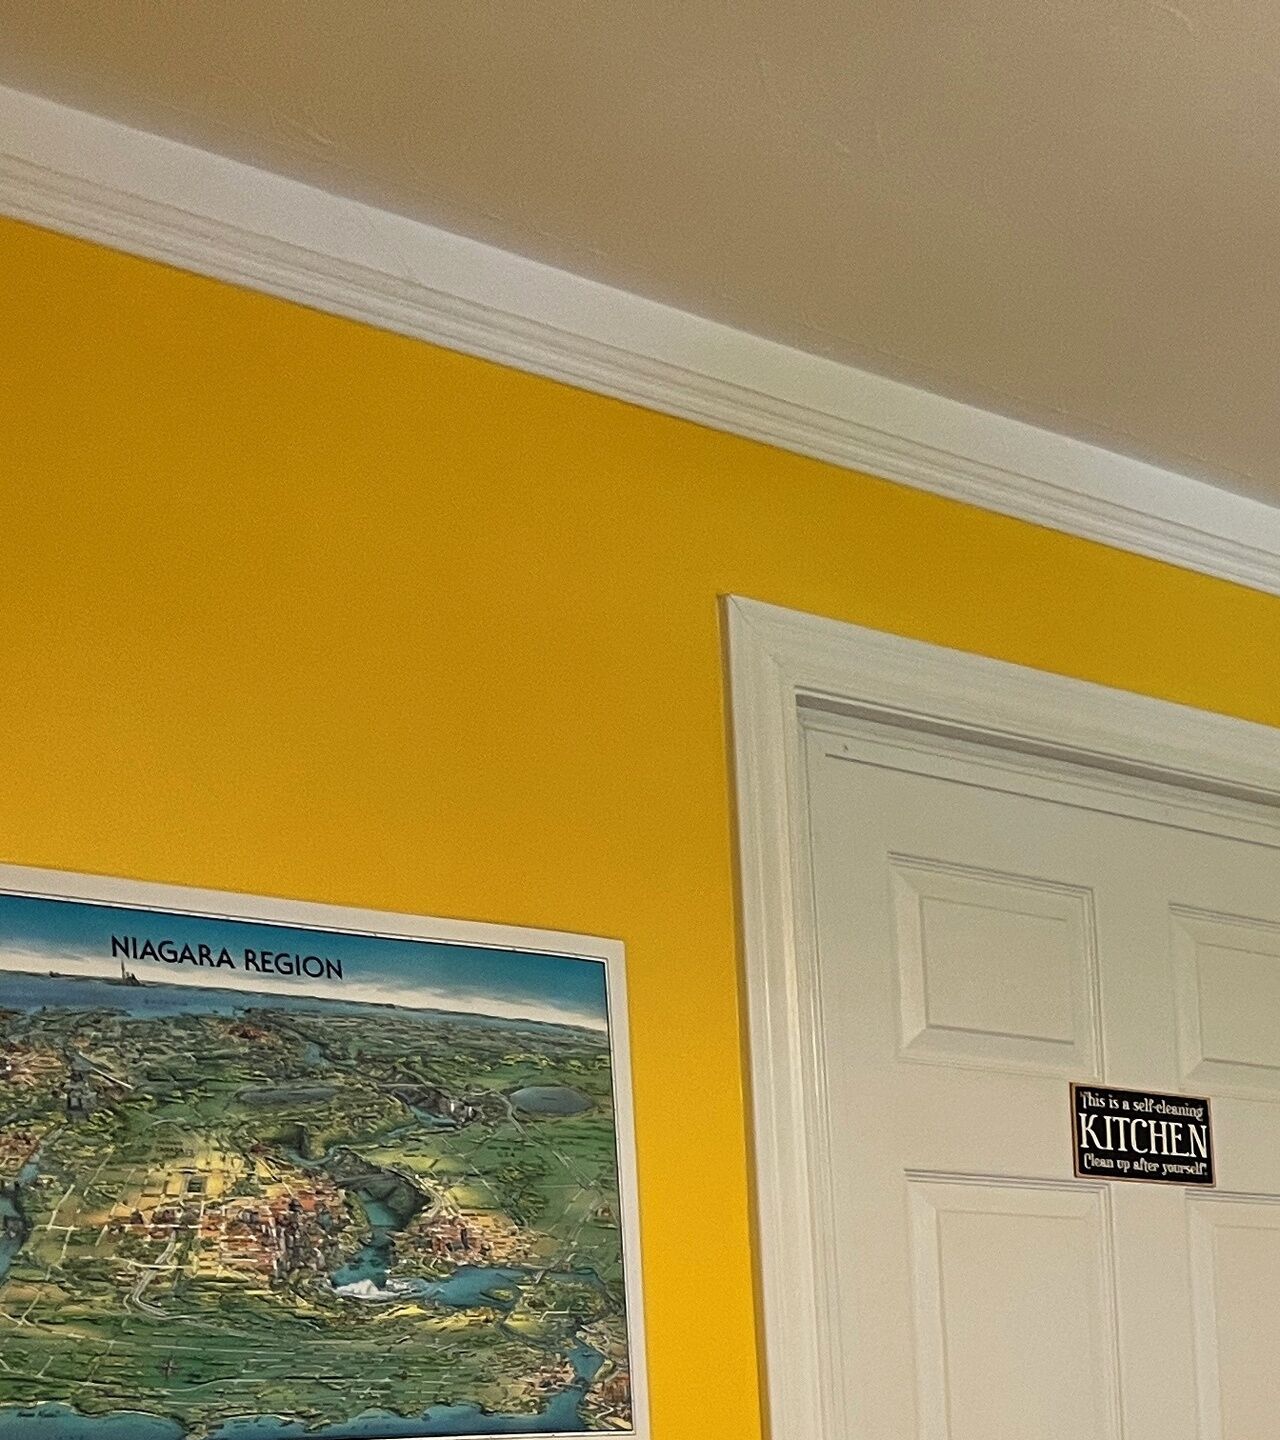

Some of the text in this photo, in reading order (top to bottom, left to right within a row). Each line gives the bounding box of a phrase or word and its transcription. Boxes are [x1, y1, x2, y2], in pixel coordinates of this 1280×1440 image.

[110, 934, 344, 981] NIAGARA REGION
[1080, 1091, 1204, 1121] This is a self-cleaning
[1078, 1112, 1208, 1159] KITCHEN
[1084, 1153, 1114, 1170] Clean
[1117, 1159, 1130, 1173] up
[1133, 1157, 1160, 1173] after
